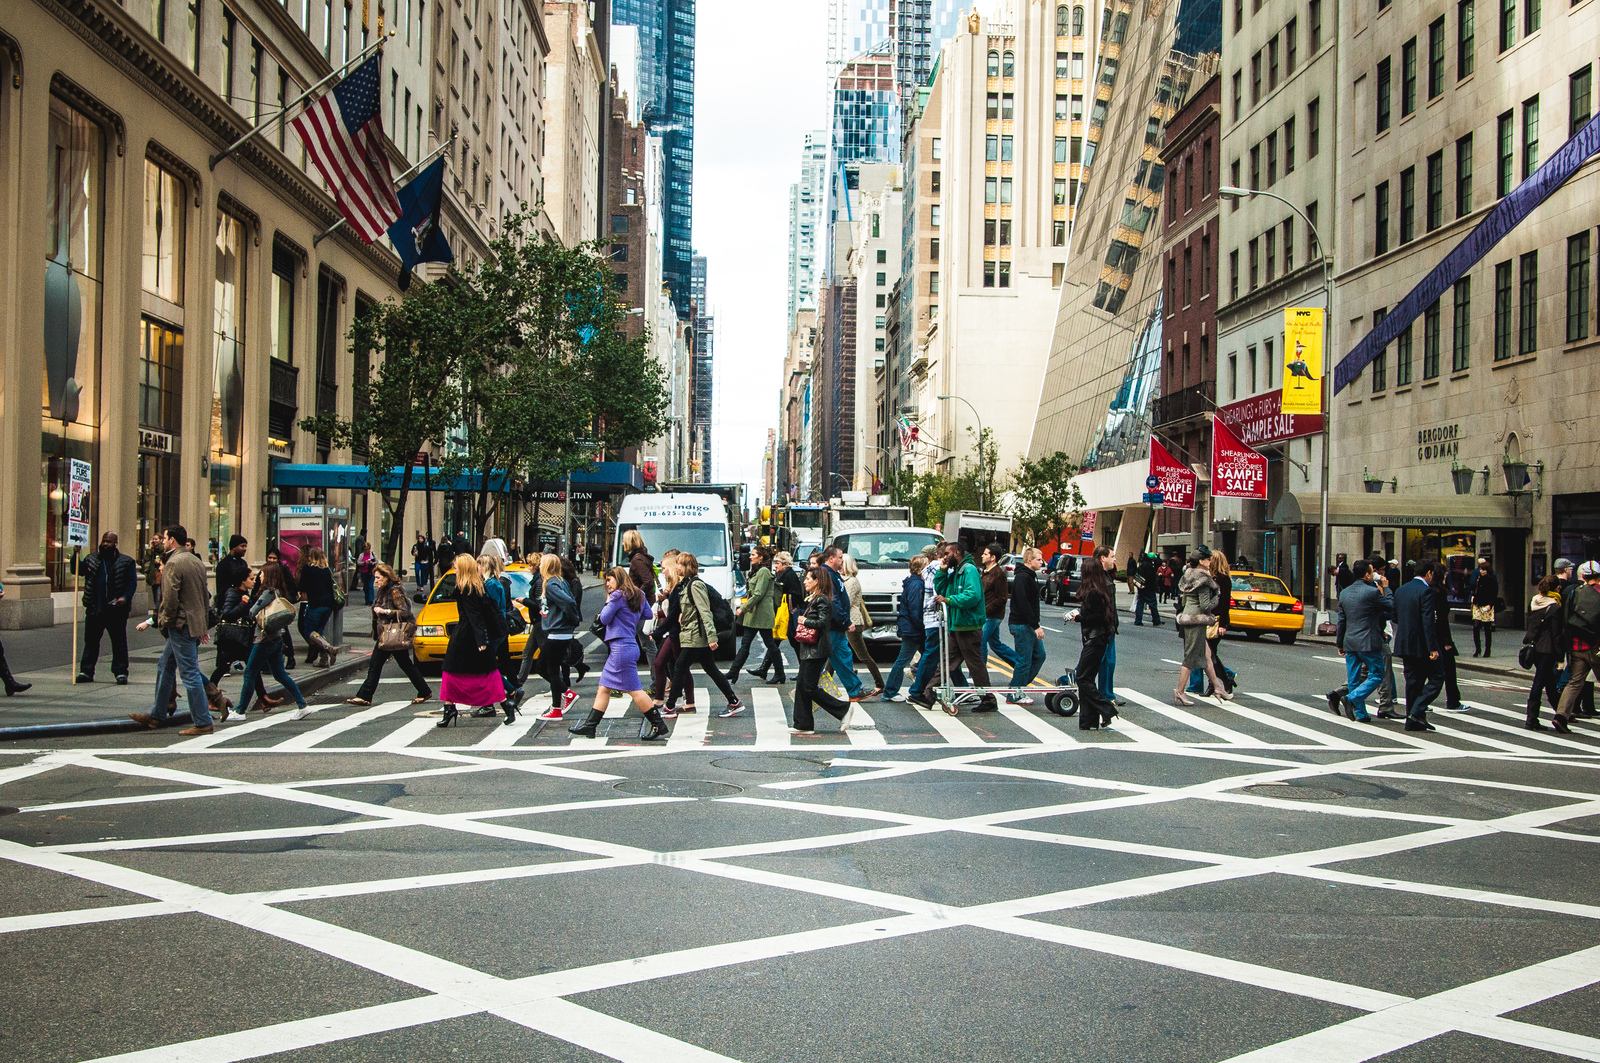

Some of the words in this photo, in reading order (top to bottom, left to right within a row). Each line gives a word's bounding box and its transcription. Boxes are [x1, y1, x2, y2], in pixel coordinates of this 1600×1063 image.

[1258, 397, 1272, 417] FURS
[1241, 417, 1272, 443] SAMPLE
[1273, 413, 1295, 438] SALE
[1417, 423, 1459, 444] BERGDORF
[1220, 449, 1260, 459] SHEARLINGS
[1417, 441, 1459, 461] GOODMAN
[1155, 465, 1191, 475] SHEARLINGS
[1217, 462, 1263, 471] ACCESSORIES
[75, 467, 88, 478] FURS
[1217, 468, 1263, 481] SAMPLE
[1157, 476, 1193, 485] CCESSORIES
[1226, 479, 1254, 491] SALE
[1157, 482, 1193, 494] AMPLE
[290, 505, 312, 513] TITAN
[674, 504, 710, 512] indigo
